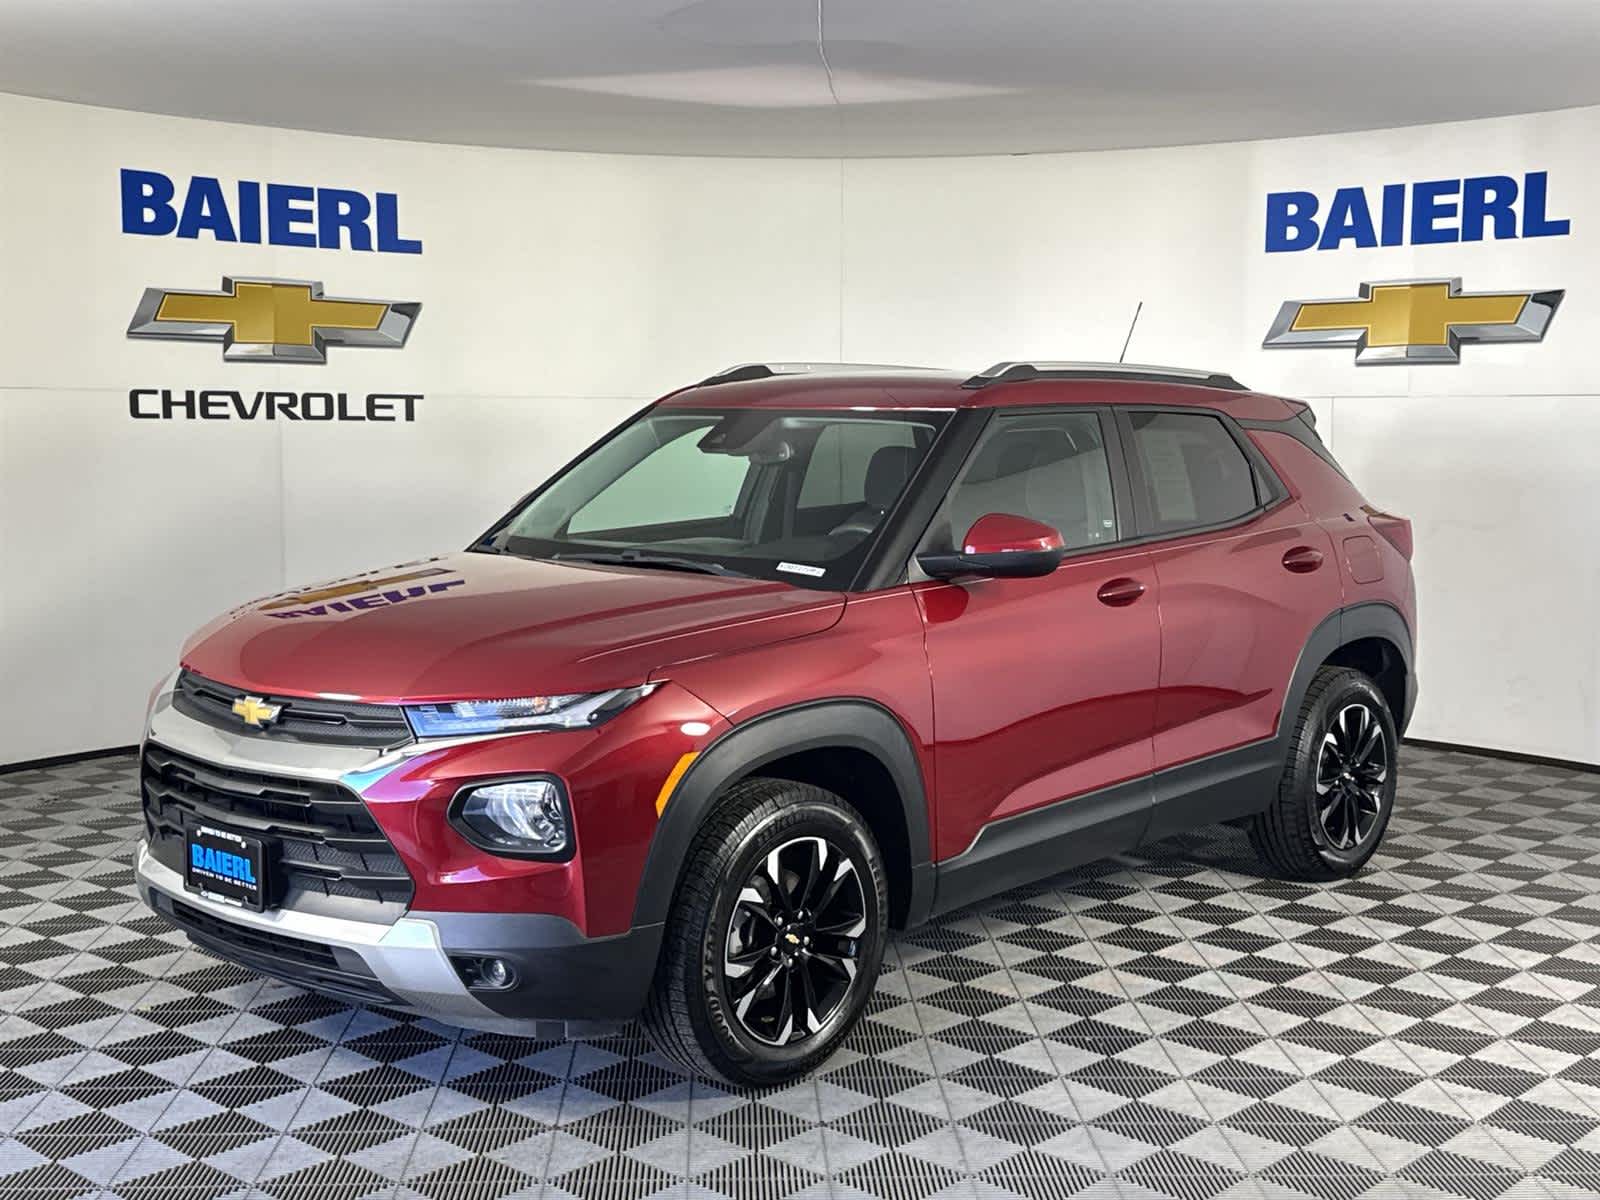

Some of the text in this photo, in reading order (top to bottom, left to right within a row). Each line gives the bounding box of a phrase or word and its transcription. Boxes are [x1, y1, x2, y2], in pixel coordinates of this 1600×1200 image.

[121, 168, 423, 254] BAIERL
[1265, 171, 1570, 253] BAIERL
[129, 389, 424, 422] CHEVROLET
[191, 843, 257, 884] BAIERL
